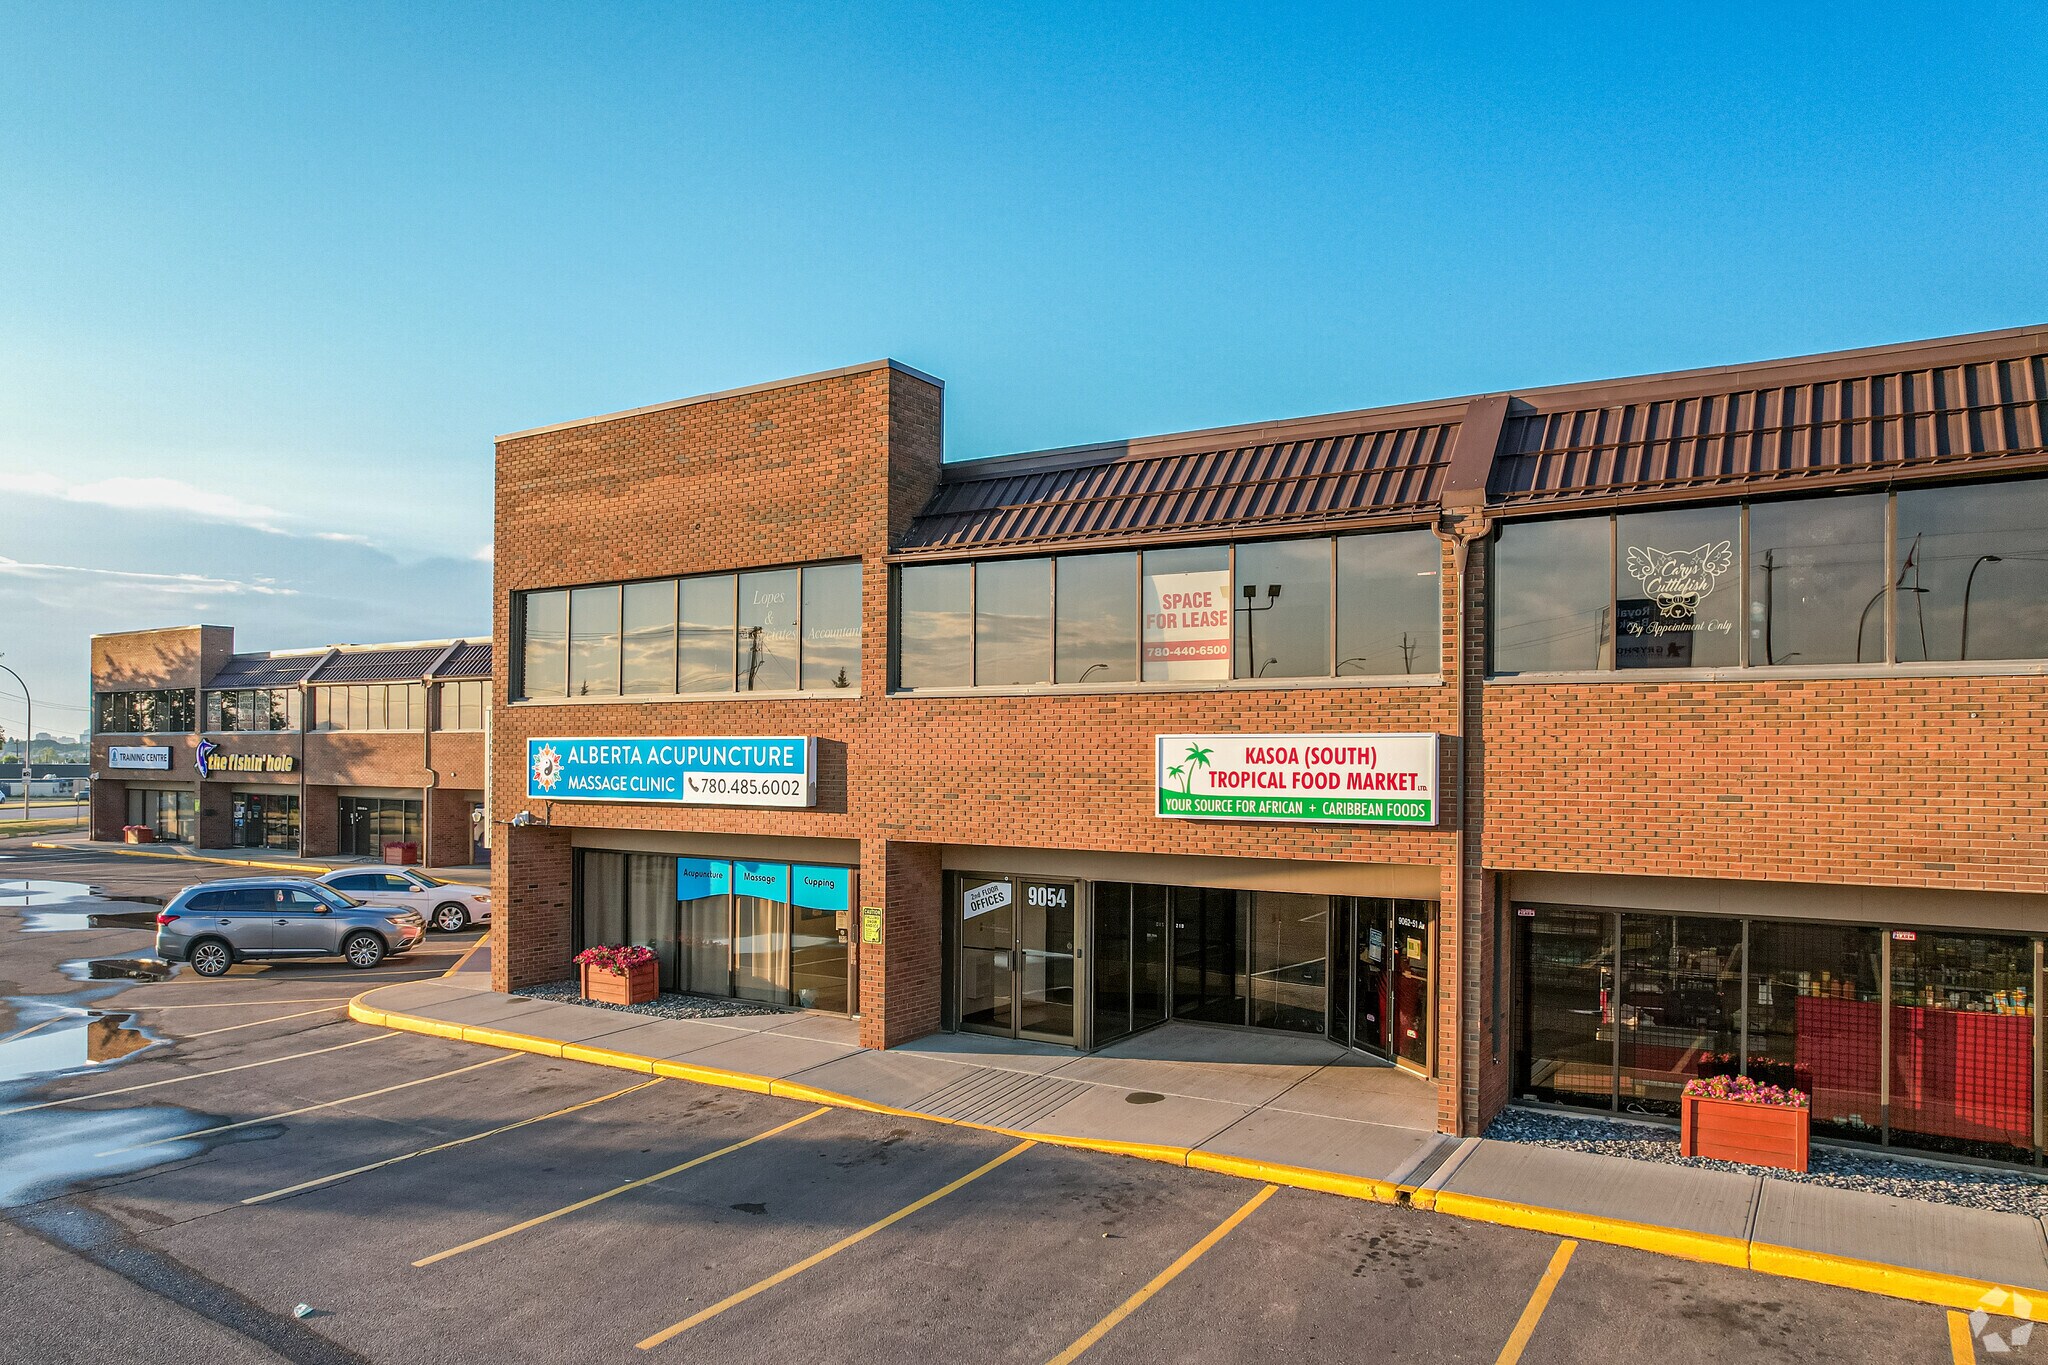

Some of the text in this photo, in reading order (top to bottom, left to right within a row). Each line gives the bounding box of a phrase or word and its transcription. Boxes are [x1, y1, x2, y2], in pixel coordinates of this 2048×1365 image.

[1661, 559, 1700, 581] Carys
[1647, 576, 1710, 595] Cuttlefish
[753, 590, 785, 608] Lopes
[1162, 592, 1212, 610] SPACE
[764, 610, 774, 625] &
[1146, 610, 1228, 630] FOR LEASE
[1627, 618, 1732, 638] By Appointment Only
[1147, 645, 1227, 656] 780-440-6500
[120, 753, 167, 762] TRAINING CENTRE
[208, 753, 293, 772] the fishin' hole
[567, 745, 795, 767] ALBERTA ACUPUNCTURE
[1245, 746, 1377, 770] KASOA (SOUTH)
[568, 776, 675, 793] MASSAGE CLINIC
[701, 778, 800, 796] 780.485.6002
[1208, 771, 1287, 789] TROPICAL
[1292, 771, 1341, 790] FOOD
[1346, 772, 1418, 791] MARKET
[1165, 798, 1192, 812] YOUR
[1194, 799, 1234, 813] SOURCE
[1236, 800, 1257, 813] FOR
[1258, 801, 1303, 814] AFRICAN
[1322, 801, 1384, 816] CARIBBEAN
[1386, 803, 1425, 818] FOODS
[683, 868, 723, 879] Acupuncture
[743, 872, 776, 884] Massage
[804, 876, 835, 889] Cupping
[981, 885, 999, 896] FLOOR
[1028, 886, 1067, 908] 9054
[970, 892, 1005, 912] OFFICES
